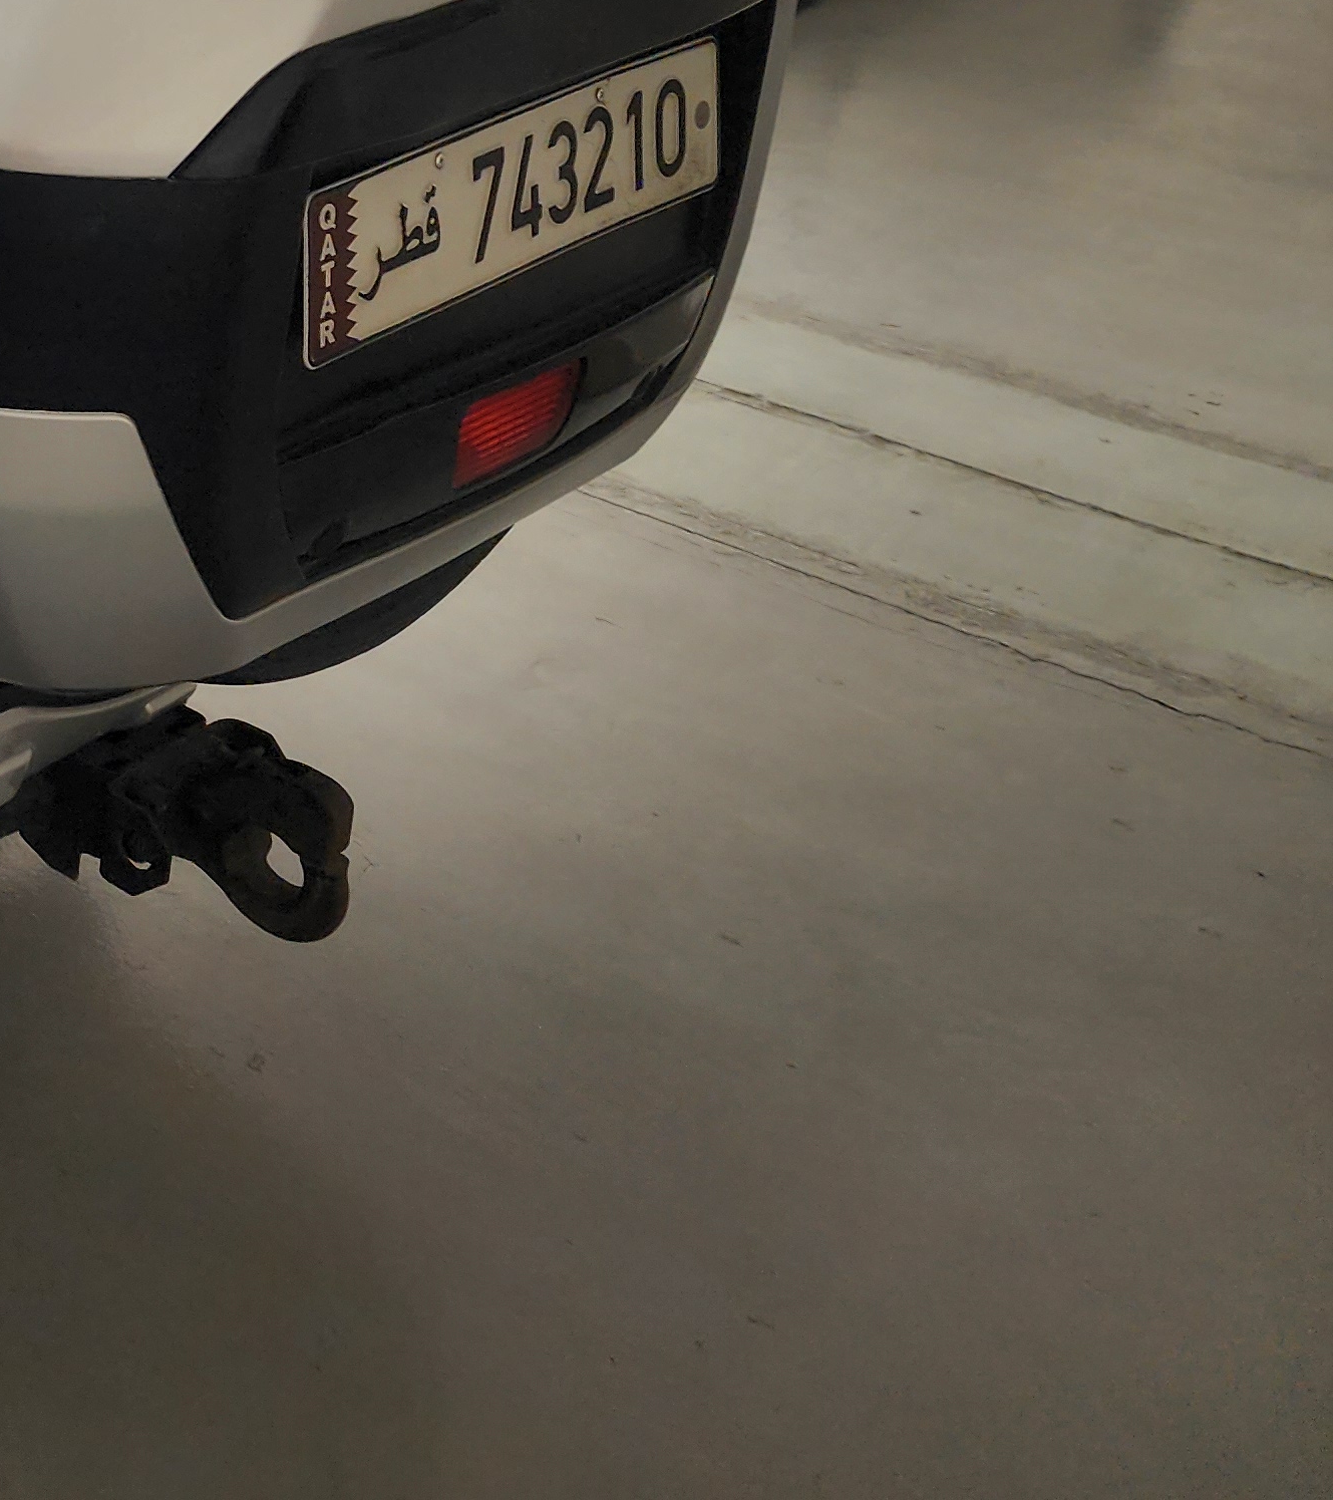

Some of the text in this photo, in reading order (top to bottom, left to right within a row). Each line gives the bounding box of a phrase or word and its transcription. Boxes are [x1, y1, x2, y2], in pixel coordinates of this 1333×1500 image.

[357, 185, 441, 301] قطر
[471, 77, 687, 265] 743210
[318, 202, 337, 349] QATAR
